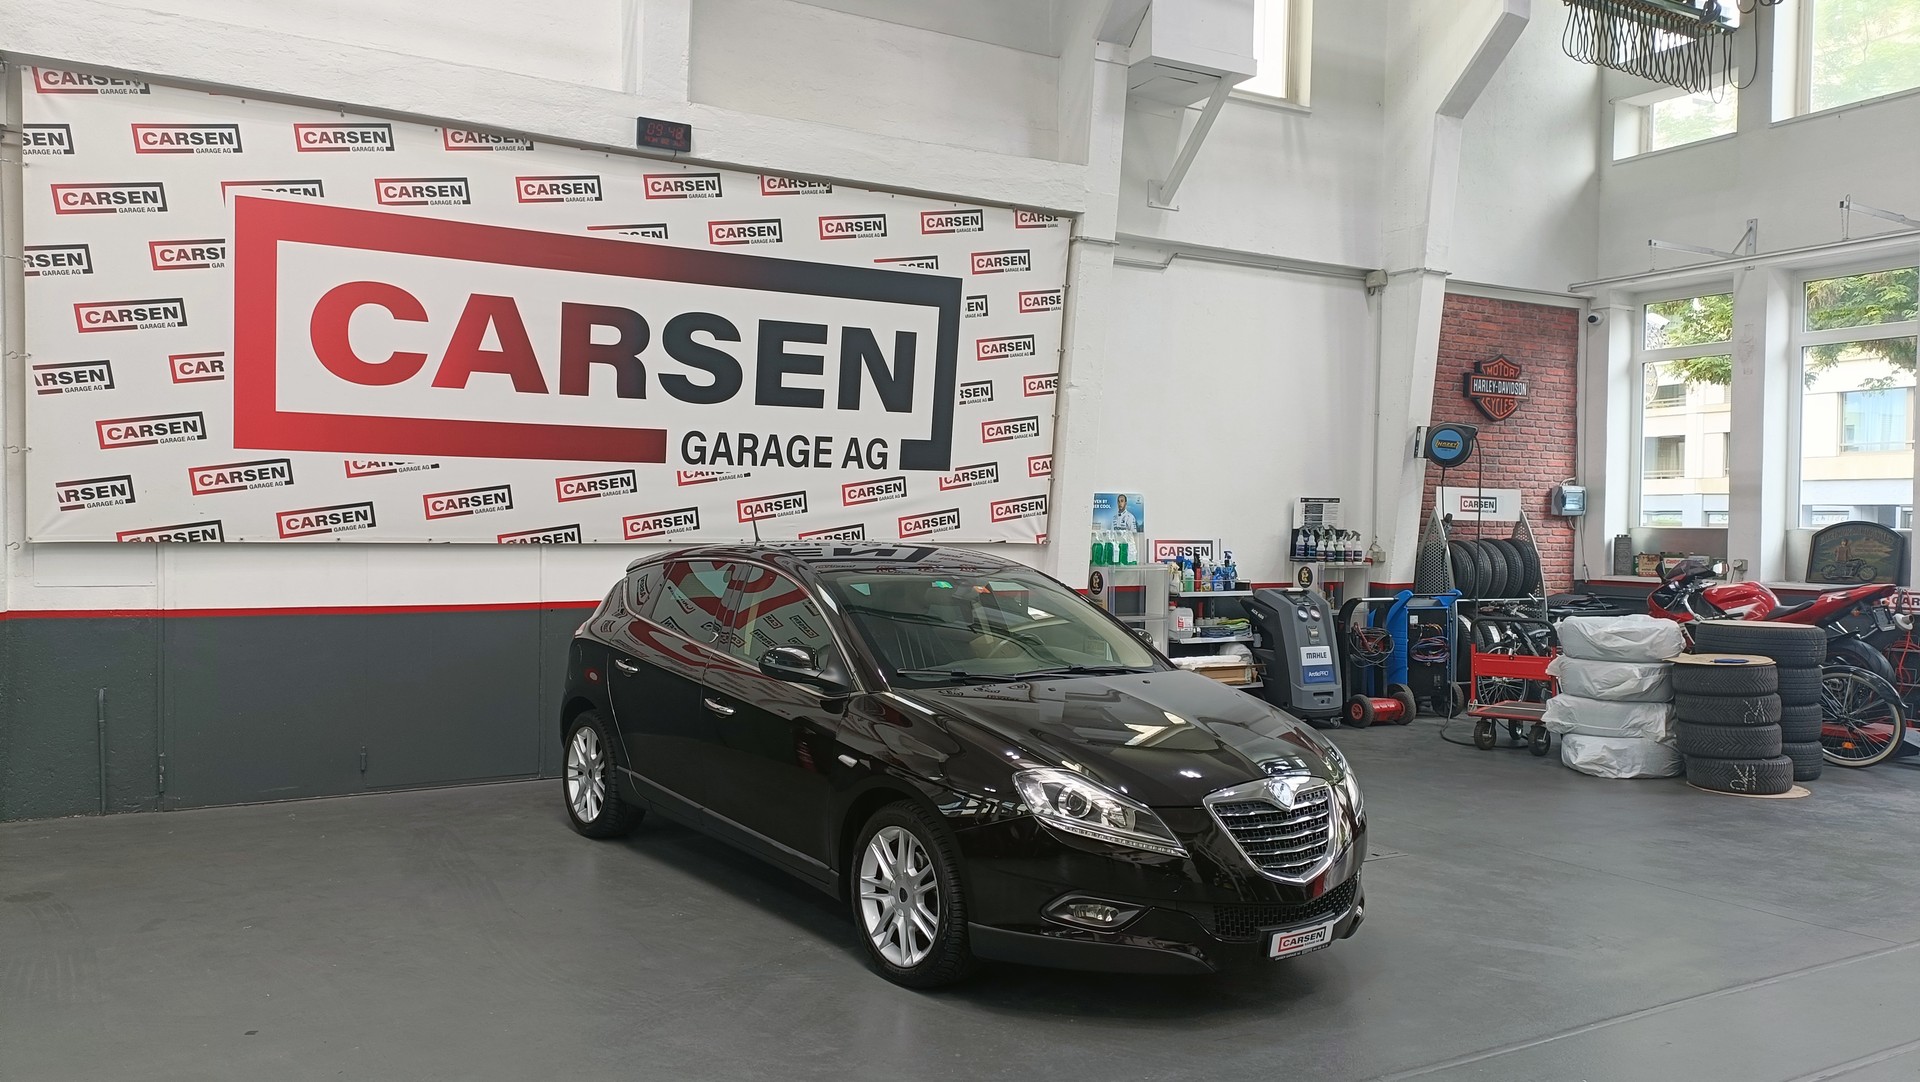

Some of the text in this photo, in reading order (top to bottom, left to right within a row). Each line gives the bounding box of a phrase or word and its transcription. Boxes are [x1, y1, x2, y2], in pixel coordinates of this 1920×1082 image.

[143, 132, 234, 145] CARSEN
[304, 132, 386, 144] CARSEN
[384, 186, 463, 198] CARSEN
[524, 183, 595, 195] CARSEN
[651, 180, 716, 192] CARSEN
[63, 191, 158, 206] CARSEN
[825, 221, 882, 233] CARSEN
[926, 216, 979, 228] CARSEN
[715, 226, 777, 238] CARSEN
[976, 256, 1026, 268] CARSEN
[85, 306, 178, 324] CARSEN
[310, 281, 917, 413] CARSEN
[982, 341, 1031, 354] CARSEN
[1487, 362, 1515, 377] MOTOR
[1486, 398, 1514, 415] CYCLES
[107, 420, 198, 440] CARSEN
[987, 422, 1035, 436] CARSEN
[681, 430, 888, 470] GARAGE AG
[199, 466, 285, 486] CARSEN
[564, 476, 631, 494] CARSEN
[848, 482, 902, 499] CARSEN
[432, 492, 506, 511] CARSEN
[996, 500, 1043, 516] CARSEN
[286, 510, 368, 530] CARSEN
[630, 514, 694, 532] CARSEN
[904, 514, 956, 531] CARSEN
[1159, 546, 1209, 557] CARSEN
[1283, 931, 1323, 946] CARSEN
